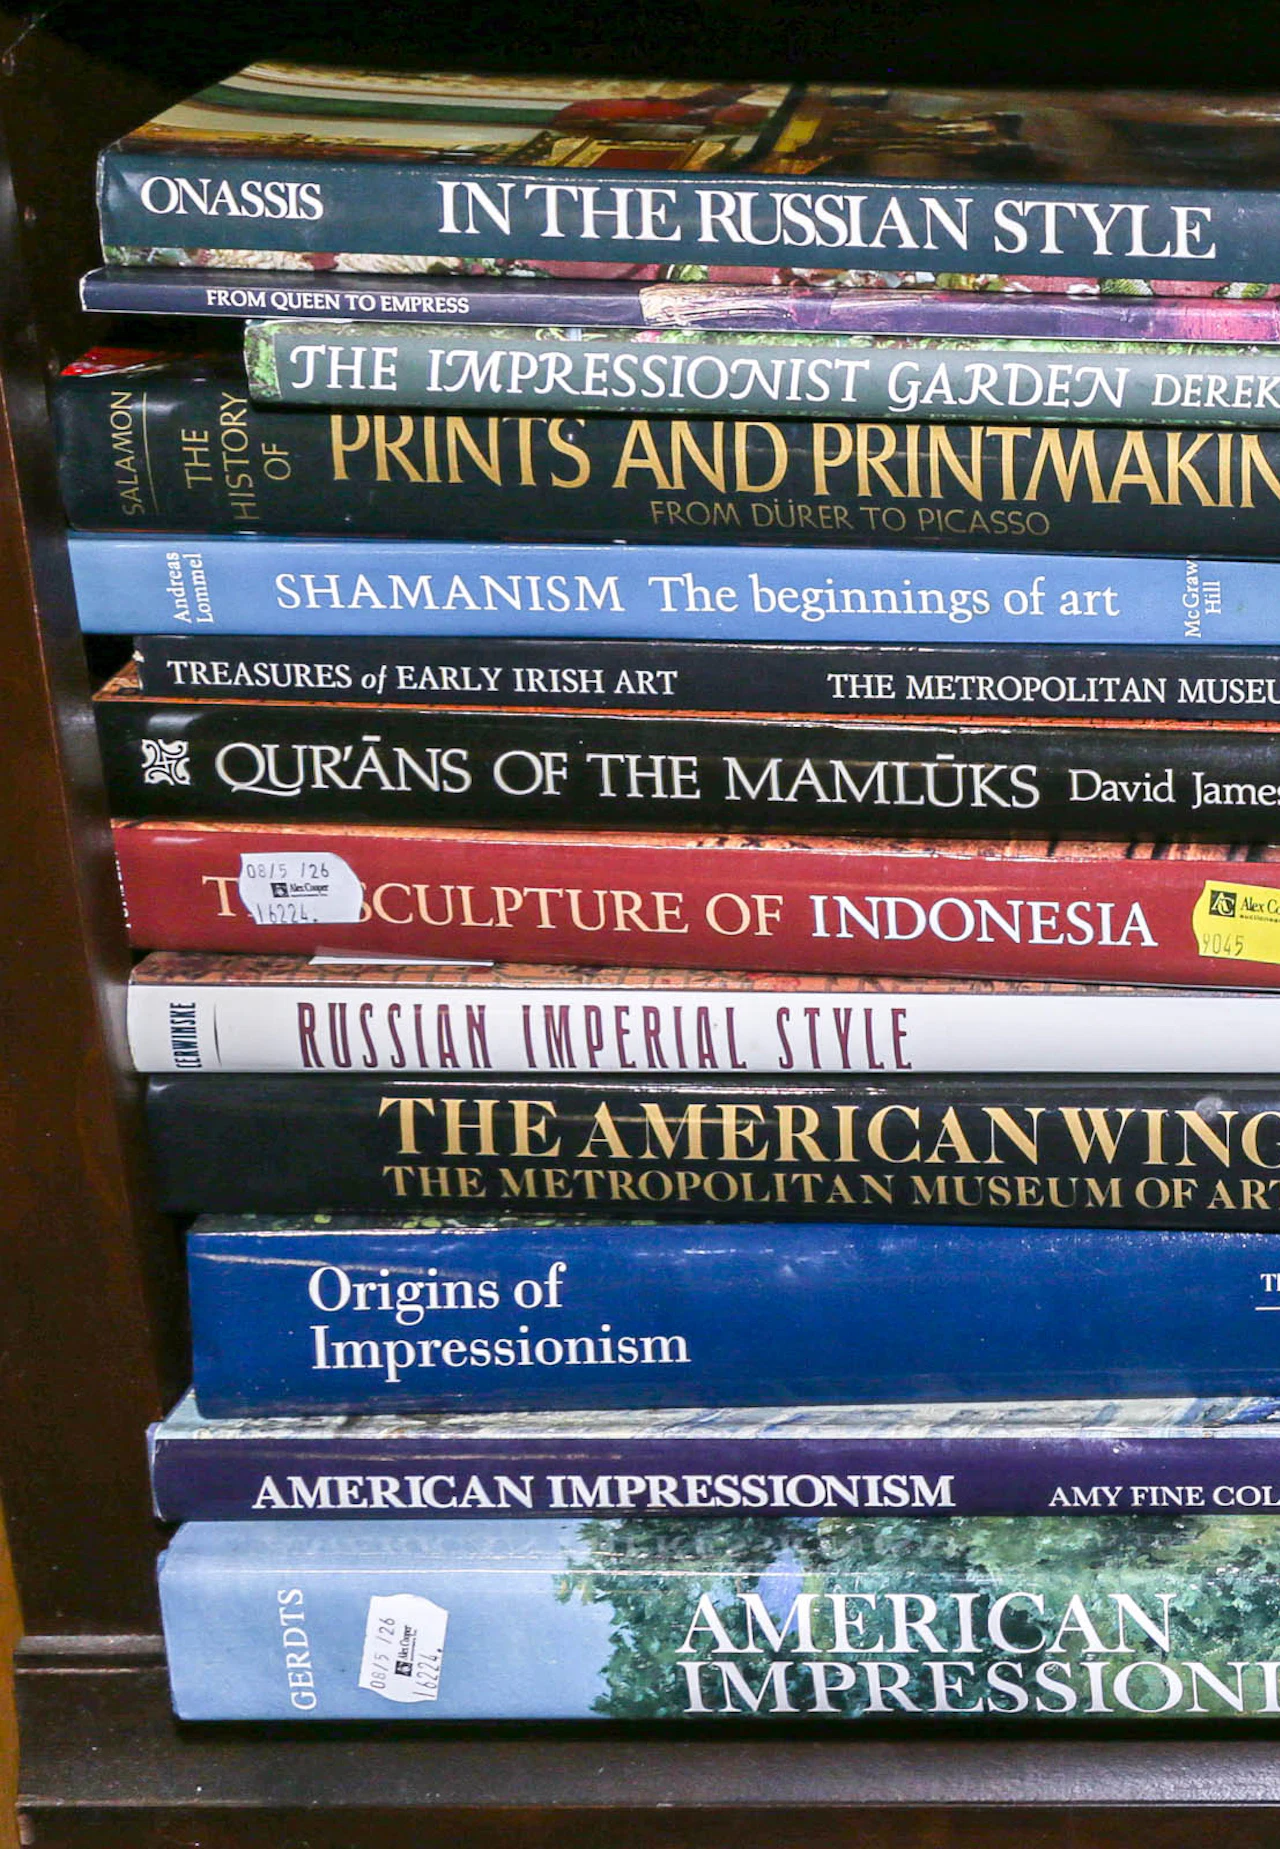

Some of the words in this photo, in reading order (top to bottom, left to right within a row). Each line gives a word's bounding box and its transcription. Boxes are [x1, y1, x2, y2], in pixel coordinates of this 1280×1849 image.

[140, 175, 323, 220] ONASSIS
[437, 181, 511, 237] IN
[525, 184, 683, 242] THE
[692, 190, 970, 251] RUSSIAN
[994, 201, 1217, 261] STYLE
[206, 289, 265, 309] FROM
[270, 290, 343, 313] QUEEN
[347, 293, 377, 312] TO
[381, 295, 470, 315] EMPRESS
[290, 346, 399, 391] THE
[427, 349, 869, 405] IMPRESSIONIST
[886, 361, 1131, 414] GARDEN
[110, 391, 145, 516] SALAMON
[330, 413, 592, 489] PRINTS
[612, 418, 788, 494] AND
[650, 500, 740, 528] FROM
[752, 498, 852, 531] DÜRER
[862, 506, 908, 532] TO
[918, 509, 1051, 536] PICASSO
[166, 552, 192, 624] Andreas
[182, 553, 214, 623] Lommel
[275, 573, 625, 614] SHAMANISM
[648, 573, 738, 614] The
[752, 575, 992, 624] beginnings
[1003, 577, 1047, 617] of
[1060, 584, 1120, 618] art
[166, 660, 353, 690] TREASURES
[360, 664, 388, 694] of
[395, 665, 503, 694] EARLY
[513, 667, 605, 696] IRISH
[614, 669, 678, 697] ART
[1240, 897, 1265, 914] Alex
[169, 1002, 202, 1068] CERWINSKE
[298, 1002, 491, 1069] RUSSIAN
[523, 1003, 747, 1070] IMPERIAL
[777, 1006, 912, 1070] STYLE
[378, 1097, 562, 1158] THE
[576, 1101, 1040, 1165] AMERICAN
[307, 1265, 500, 1325] Origins
[513, 1261, 566, 1309] of
[309, 1324, 692, 1383] Impressionism
[277, 1587, 317, 1712] GERDTS
[676, 1590, 1173, 1654] AMERICAN
